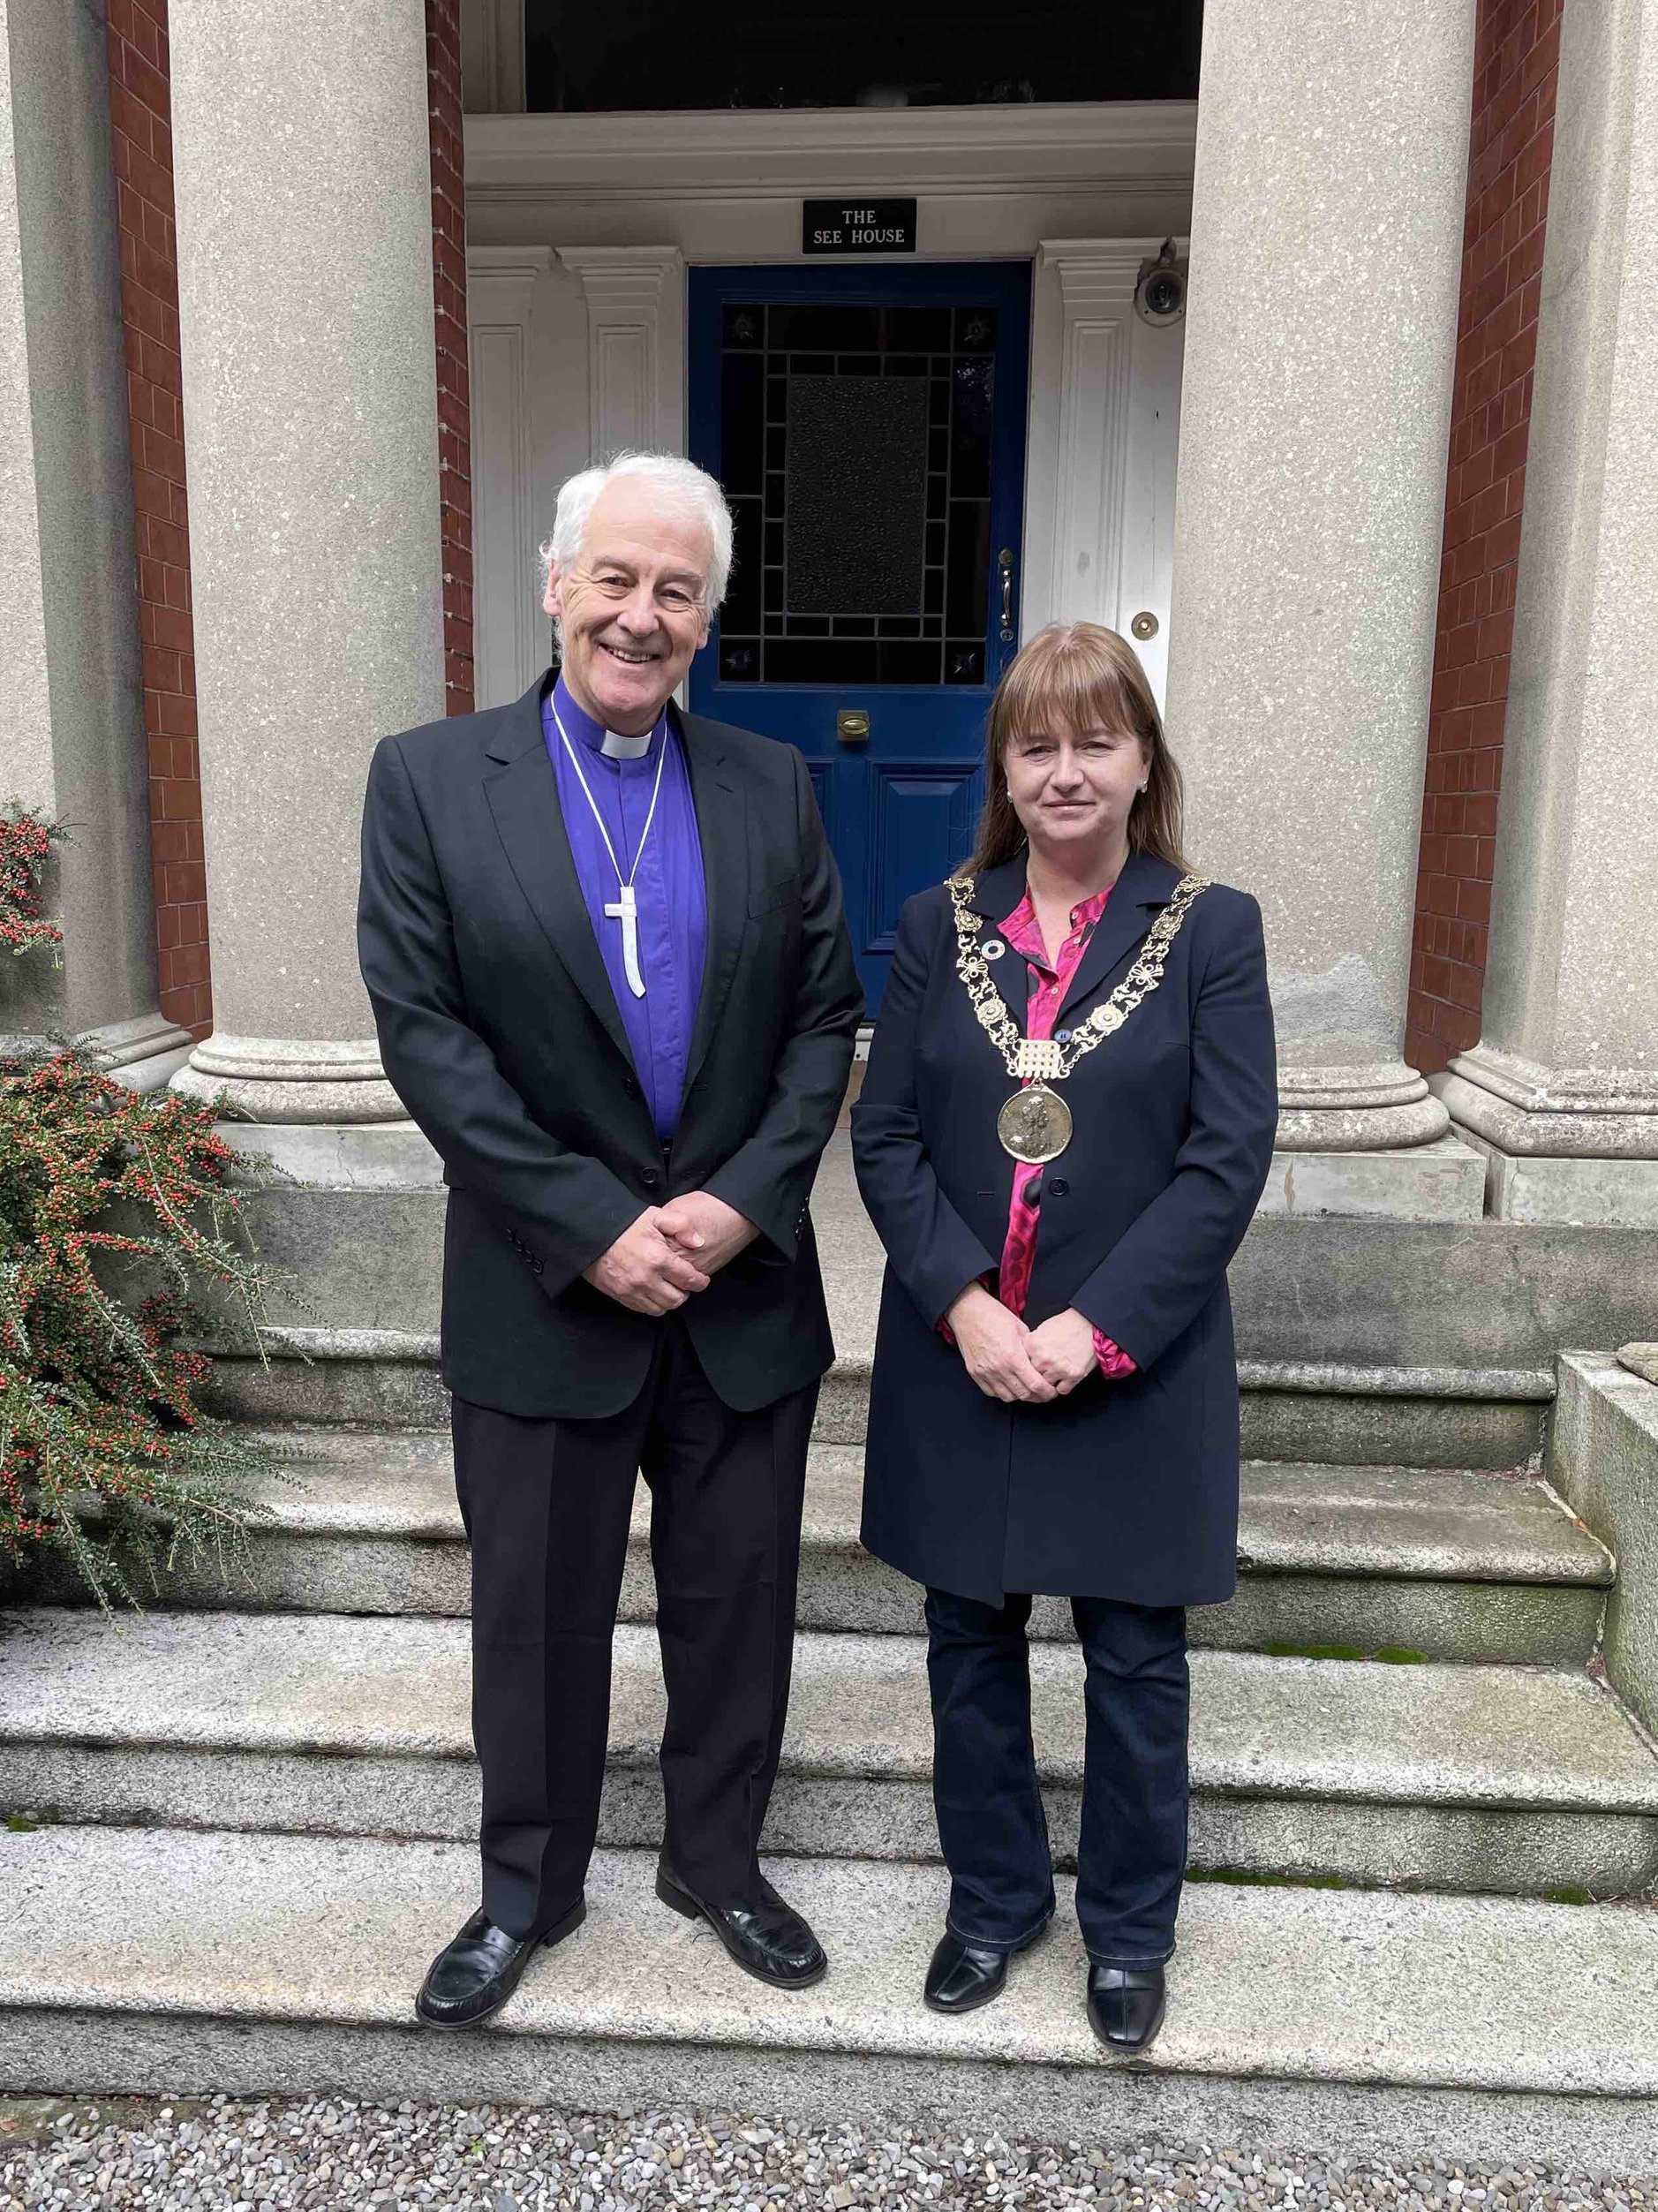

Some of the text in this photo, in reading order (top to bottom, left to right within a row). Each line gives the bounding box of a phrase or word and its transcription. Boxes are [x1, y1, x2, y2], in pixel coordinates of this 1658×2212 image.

[842, 210, 876, 224] THE
[813, 229, 905, 244] SEE HOUSE
